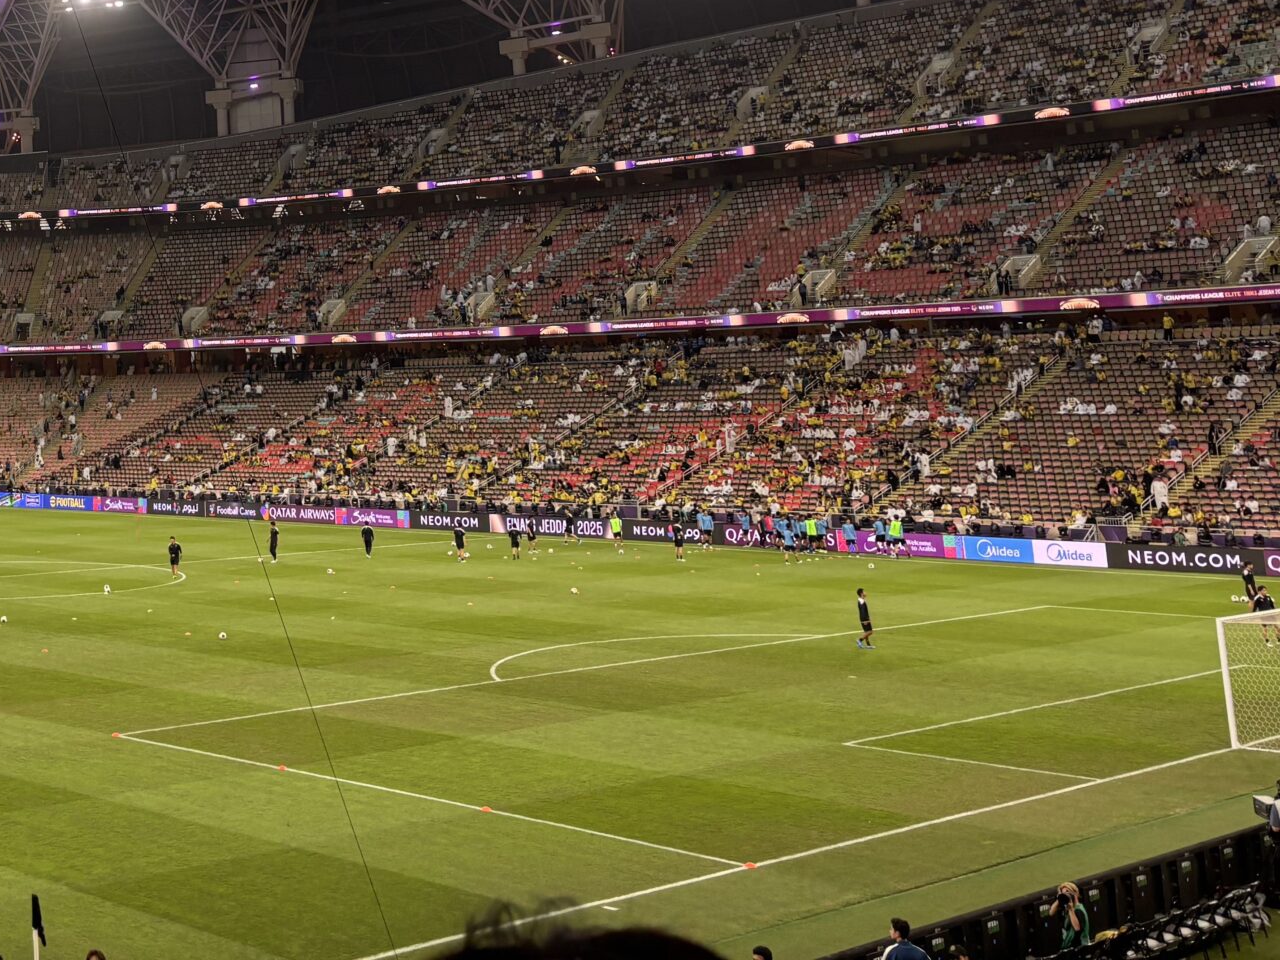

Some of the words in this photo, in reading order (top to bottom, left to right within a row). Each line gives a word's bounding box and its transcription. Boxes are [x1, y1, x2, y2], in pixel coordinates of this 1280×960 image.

[153, 503, 172, 511] NEOM
[217, 505, 238, 516] Football
[239, 506, 257, 517] Cares
[269, 507, 297, 520] QATAR
[299, 509, 335, 521] AIRWAYS
[420, 515, 479, 528] NEOM.COM
[539, 519, 574, 534] JEDDA
[577, 521, 603, 536] 2025
[633, 526, 665, 537] NEOM
[981, 543, 1020, 558] Midea
[1051, 547, 1093, 562] Midea
[1127, 549, 1241, 569] NEOM.COM
